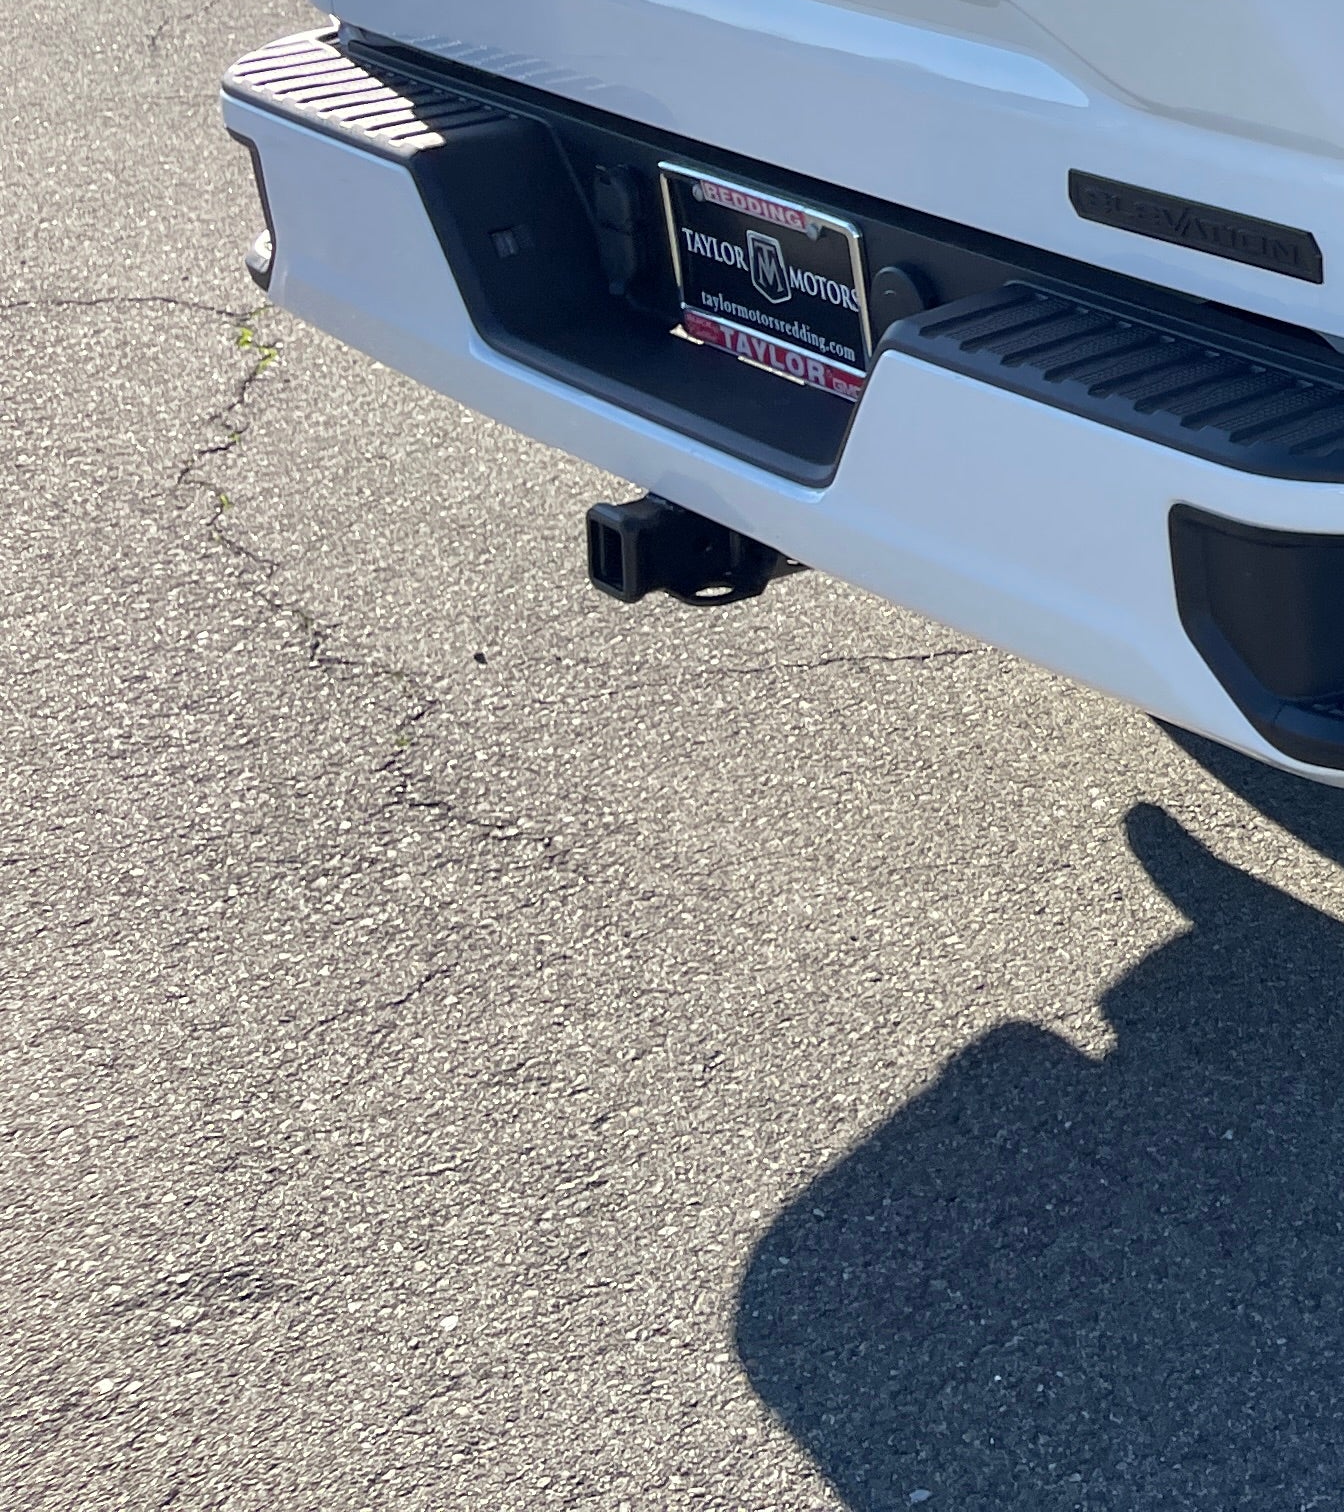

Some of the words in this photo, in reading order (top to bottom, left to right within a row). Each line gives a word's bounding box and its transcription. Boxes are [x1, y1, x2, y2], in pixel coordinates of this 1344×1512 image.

[704, 182, 804, 229] REDDING
[681, 227, 749, 271] TAYLOR
[788, 265, 860, 312] MOTORS
[701, 290, 856, 363] taylormotorsredding.com
[719, 325, 828, 386] TAYLOR
